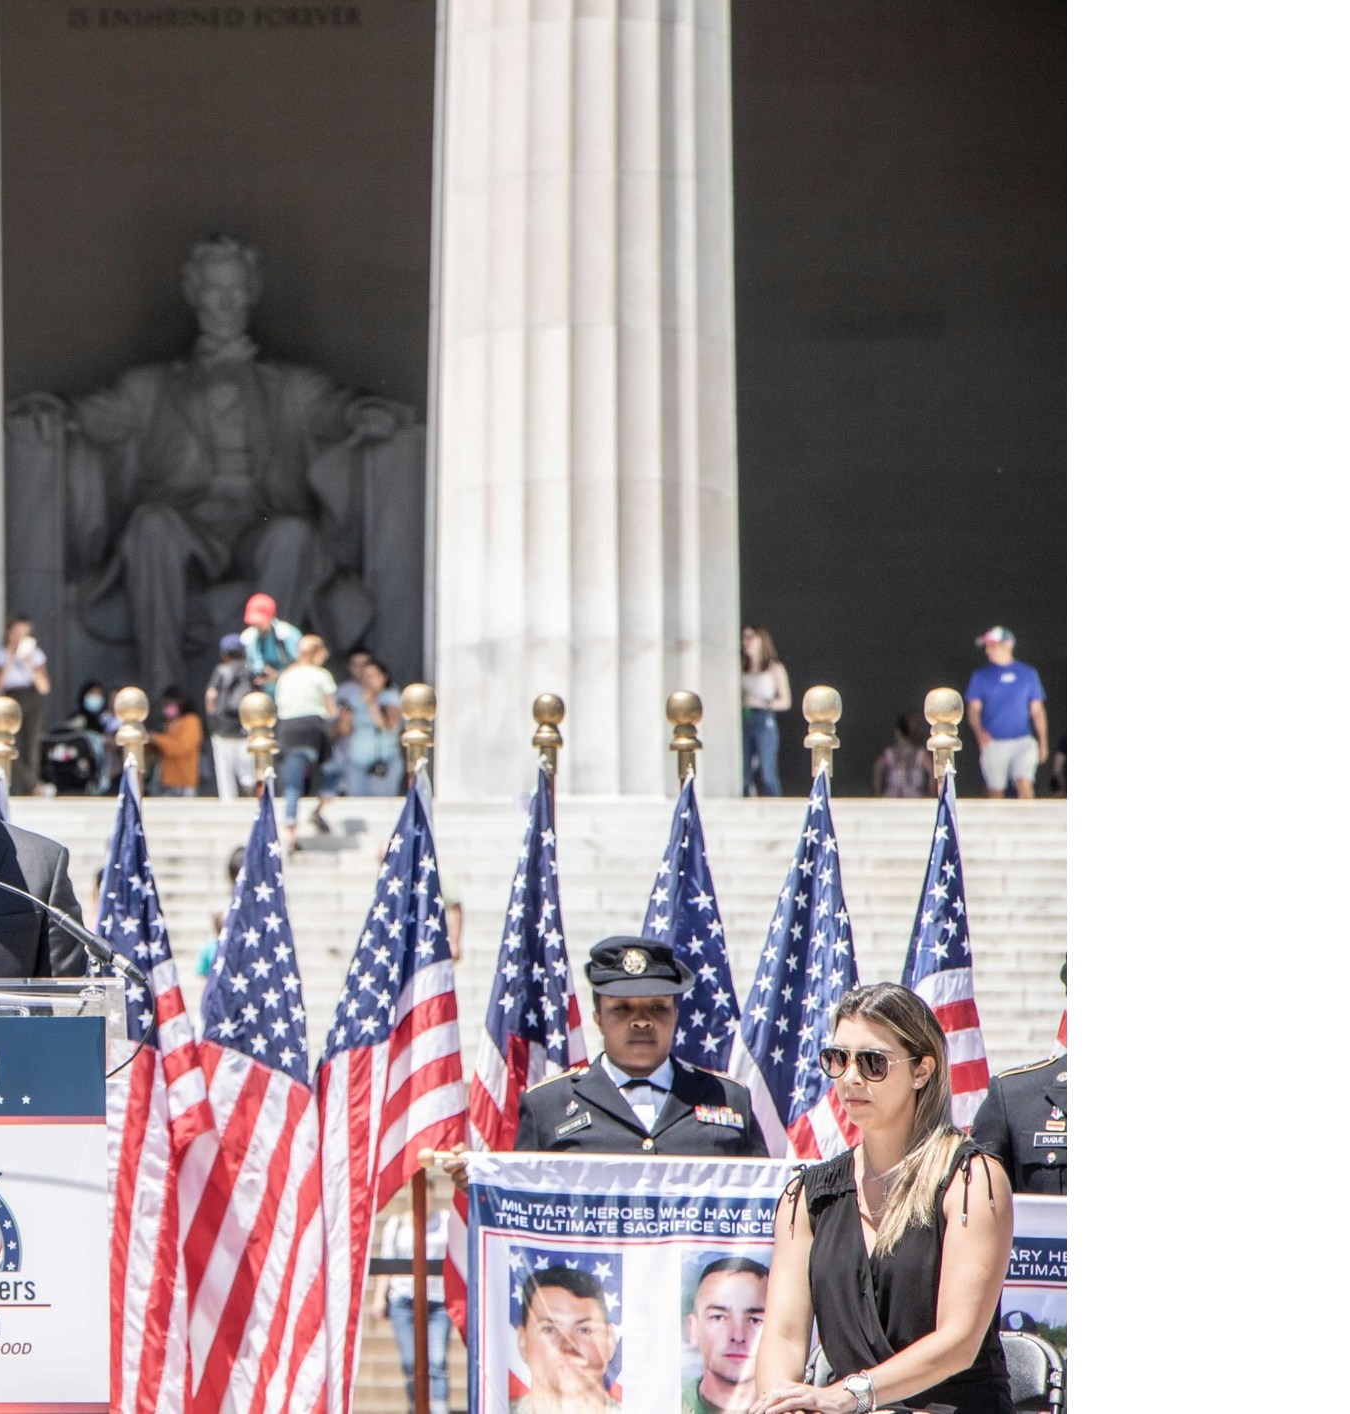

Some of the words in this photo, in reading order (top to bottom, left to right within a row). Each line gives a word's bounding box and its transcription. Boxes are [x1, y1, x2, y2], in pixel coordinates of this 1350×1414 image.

[501, 1199, 579, 1218] MILITARY
[584, 1206, 655, 1220] HEROES
[660, 1207, 697, 1220] WHO
[705, 1207, 752, 1221] HAVE
[495, 1212, 529, 1228] THE
[533, 1217, 618, 1233] ULTIMATE
[623, 1221, 715, 1234] SACRIFICE
[720, 1221, 773, 1234] SINCE
